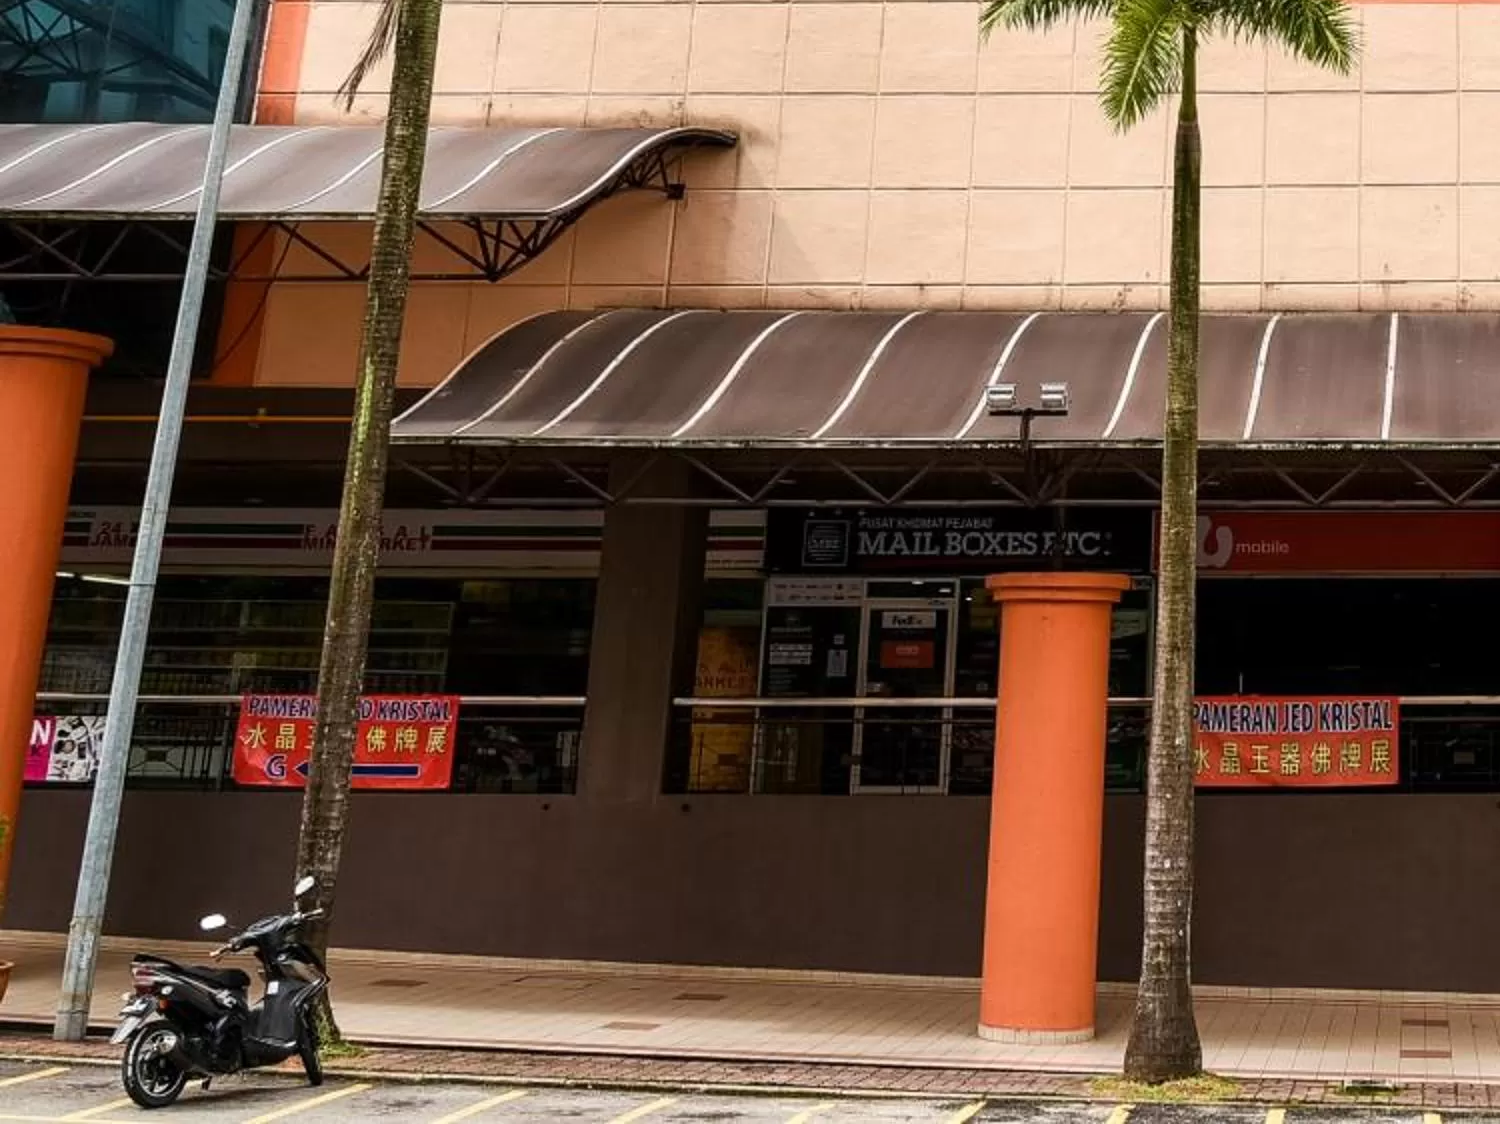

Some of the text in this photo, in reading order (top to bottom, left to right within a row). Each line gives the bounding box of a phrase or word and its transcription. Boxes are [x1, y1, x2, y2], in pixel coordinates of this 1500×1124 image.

[856, 531, 941, 556] MAIL
[943, 531, 1038, 556] BOXES
[1235, 540, 1290, 555] mobile
[249, 697, 316, 718] PAMER
[378, 701, 451, 721] KRISTAL
[1282, 702, 1314, 732] JED
[1319, 700, 1394, 731] KRISTAL
[244, 723, 448, 754] 水晶佛牌展
[266, 753, 287, 779] G
